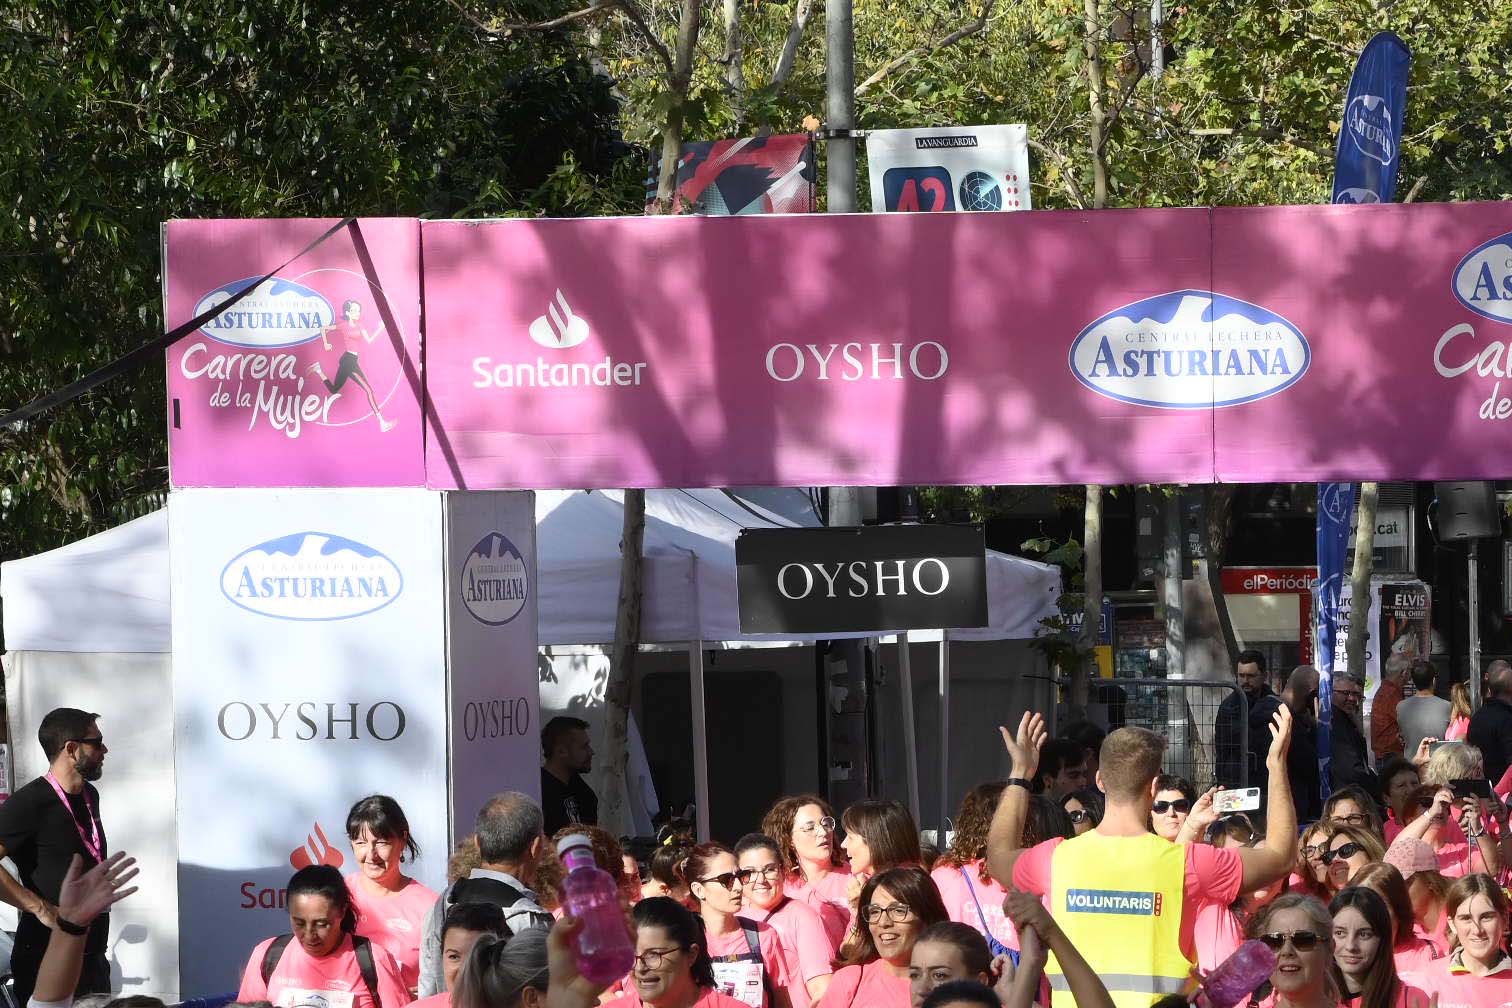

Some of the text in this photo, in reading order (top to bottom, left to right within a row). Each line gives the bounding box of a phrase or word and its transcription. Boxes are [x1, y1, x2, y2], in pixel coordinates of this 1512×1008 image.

[928, 137, 977, 148] VANGUARDIA
[204, 302, 323, 330] ASTURIANA
[1209, 330, 1283, 343] LECHERA
[180, 343, 298, 380] Carrera
[472, 355, 647, 388] Santander
[765, 341, 949, 382] OYSHO
[1088, 335, 1292, 378] ASTURIANA
[209, 381, 251, 408] de la
[247, 374, 343, 439] Mujer
[1479, 380, 1512, 421] de
[237, 565, 389, 599] ASTURIANA
[466, 565, 524, 602] ASTURIANA
[777, 558, 950, 600] OYSHO
[1395, 593, 1425, 607] ELVIS
[217, 701, 406, 742] OYSHO
[463, 697, 530, 742] OYSHO
[1067, 894, 1152, 911] VOLUNTARIS
